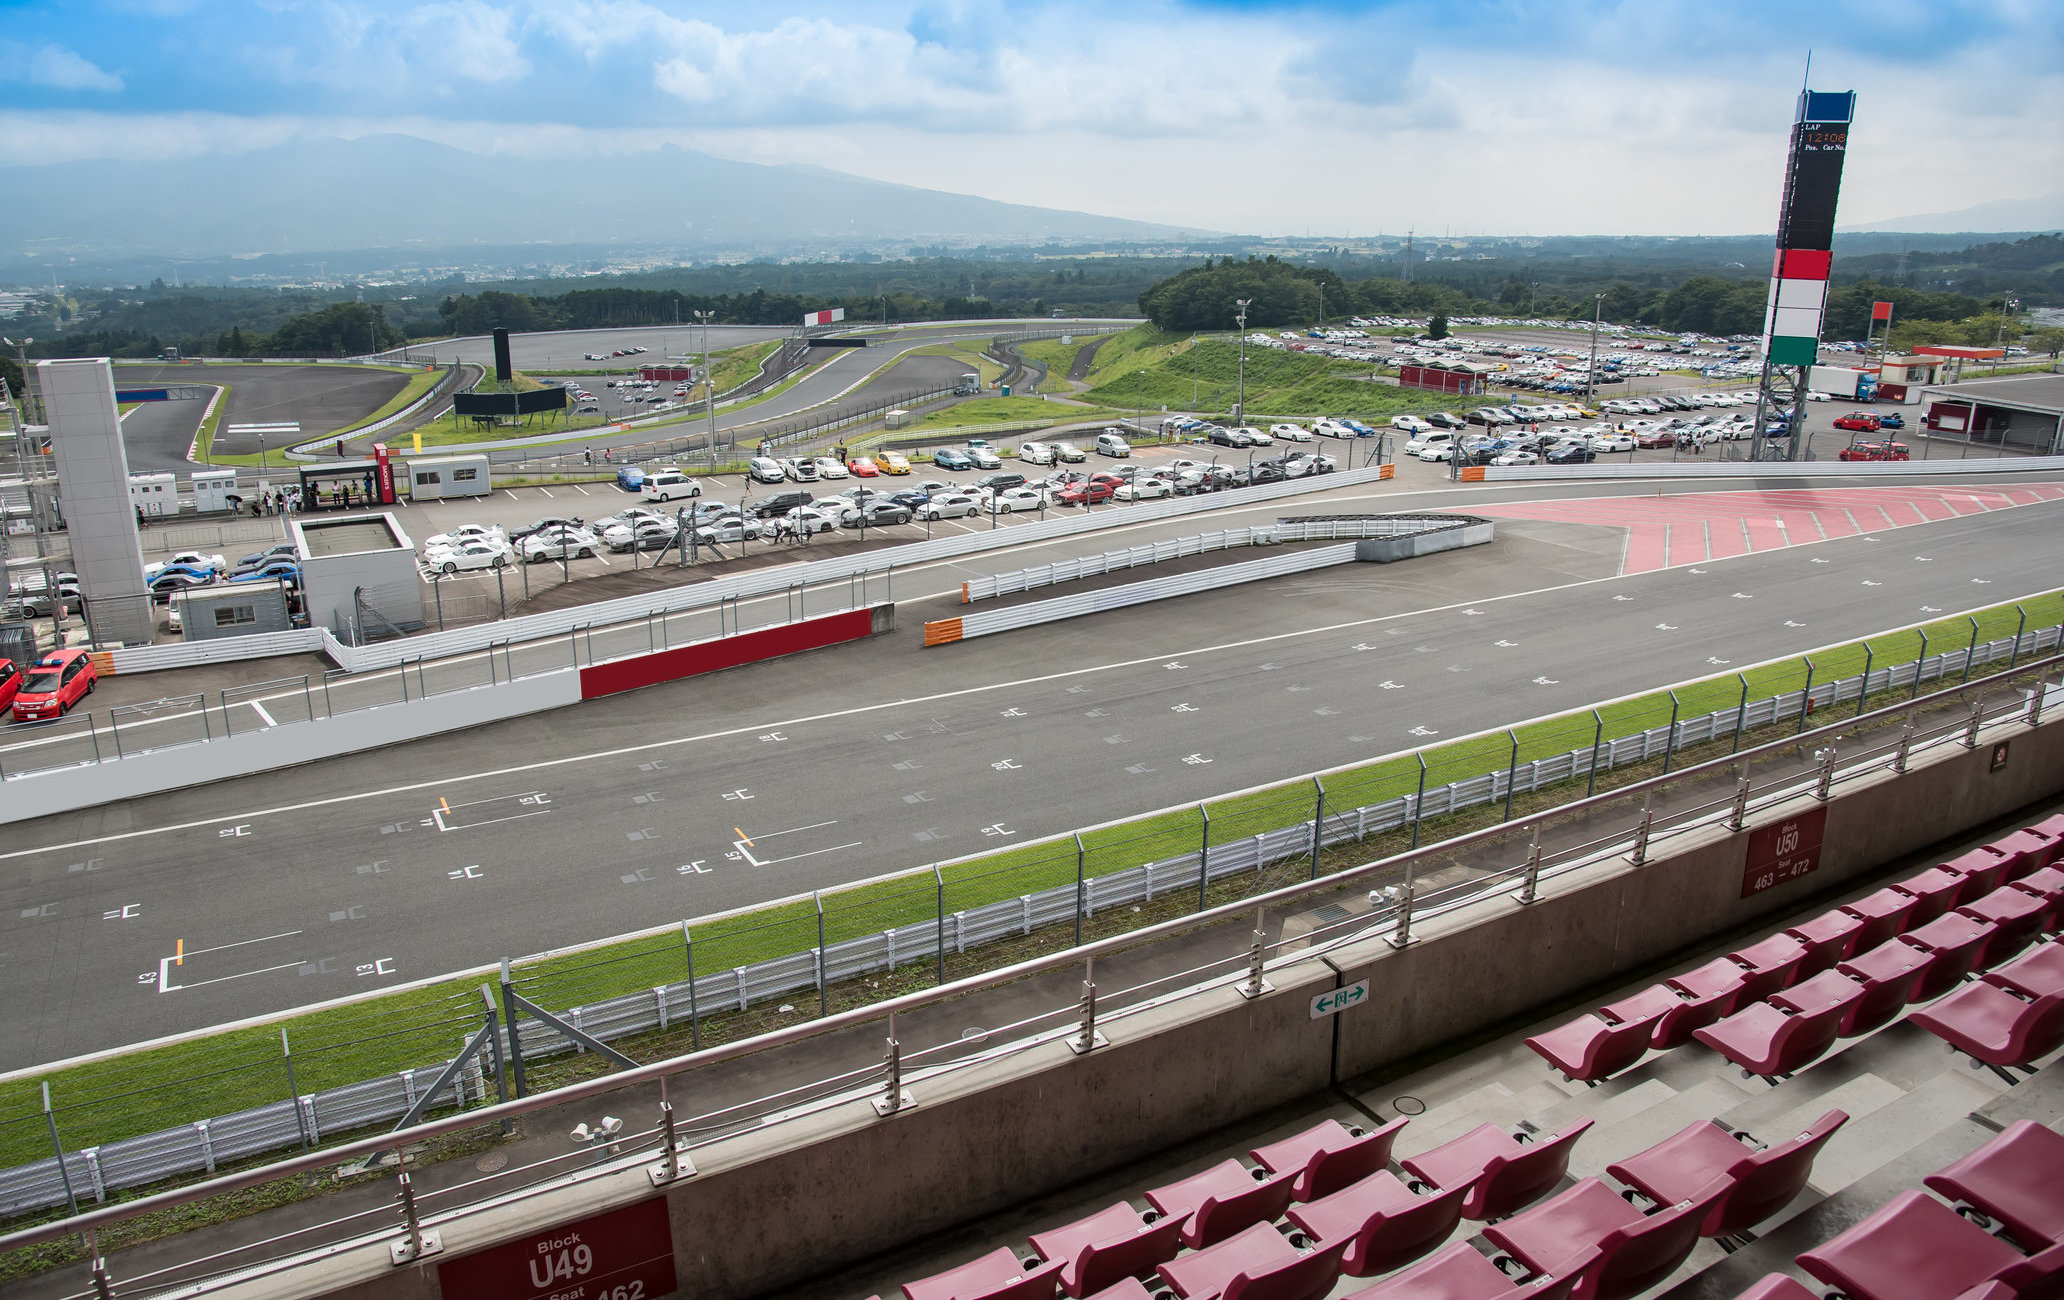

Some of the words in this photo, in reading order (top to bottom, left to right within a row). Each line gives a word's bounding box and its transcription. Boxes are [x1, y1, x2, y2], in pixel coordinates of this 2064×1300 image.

[1776, 830, 1799, 856] U50
[1754, 872, 1774, 890] 463
[1791, 858, 1810, 876] 472
[355, 963, 375, 976] 13
[537, 1232, 581, 1255] Block
[529, 1244, 593, 1288] U49
